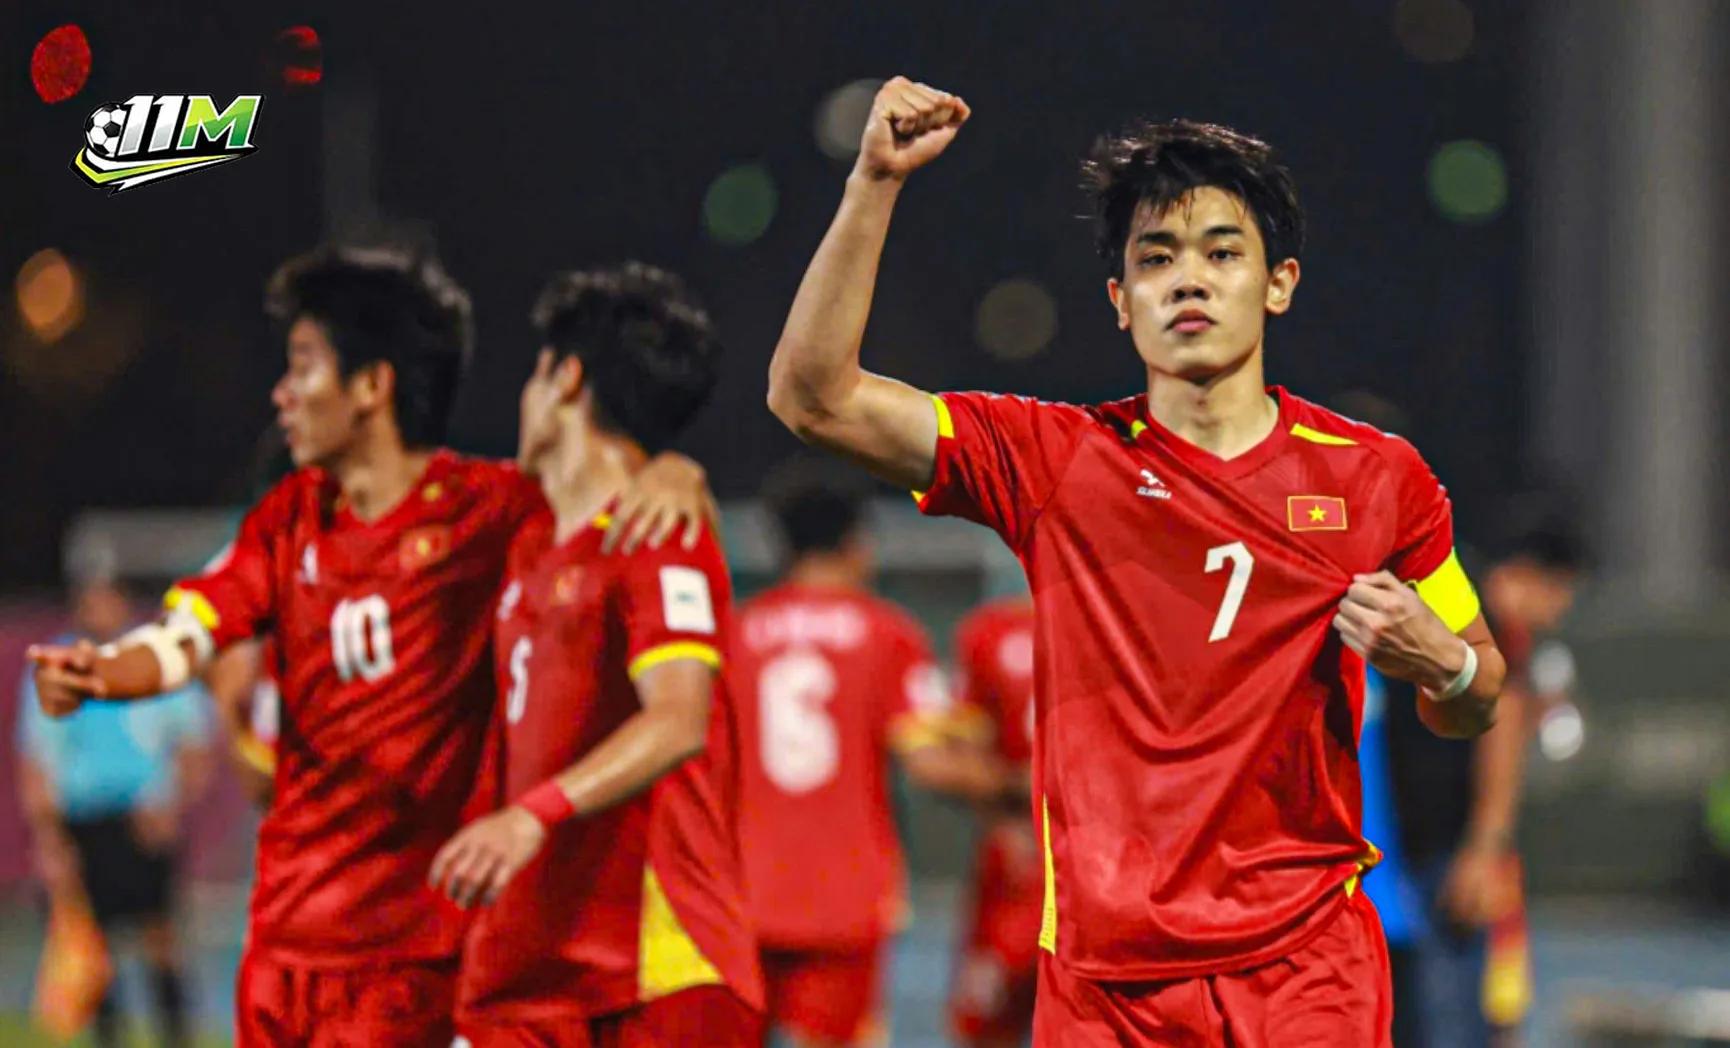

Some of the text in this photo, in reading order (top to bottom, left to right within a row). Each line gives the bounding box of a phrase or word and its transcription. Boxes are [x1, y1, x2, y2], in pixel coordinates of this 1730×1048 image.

[331, 594, 396, 683] 10
[1204, 541, 1254, 643] 7
[760, 650, 839, 794] 6
